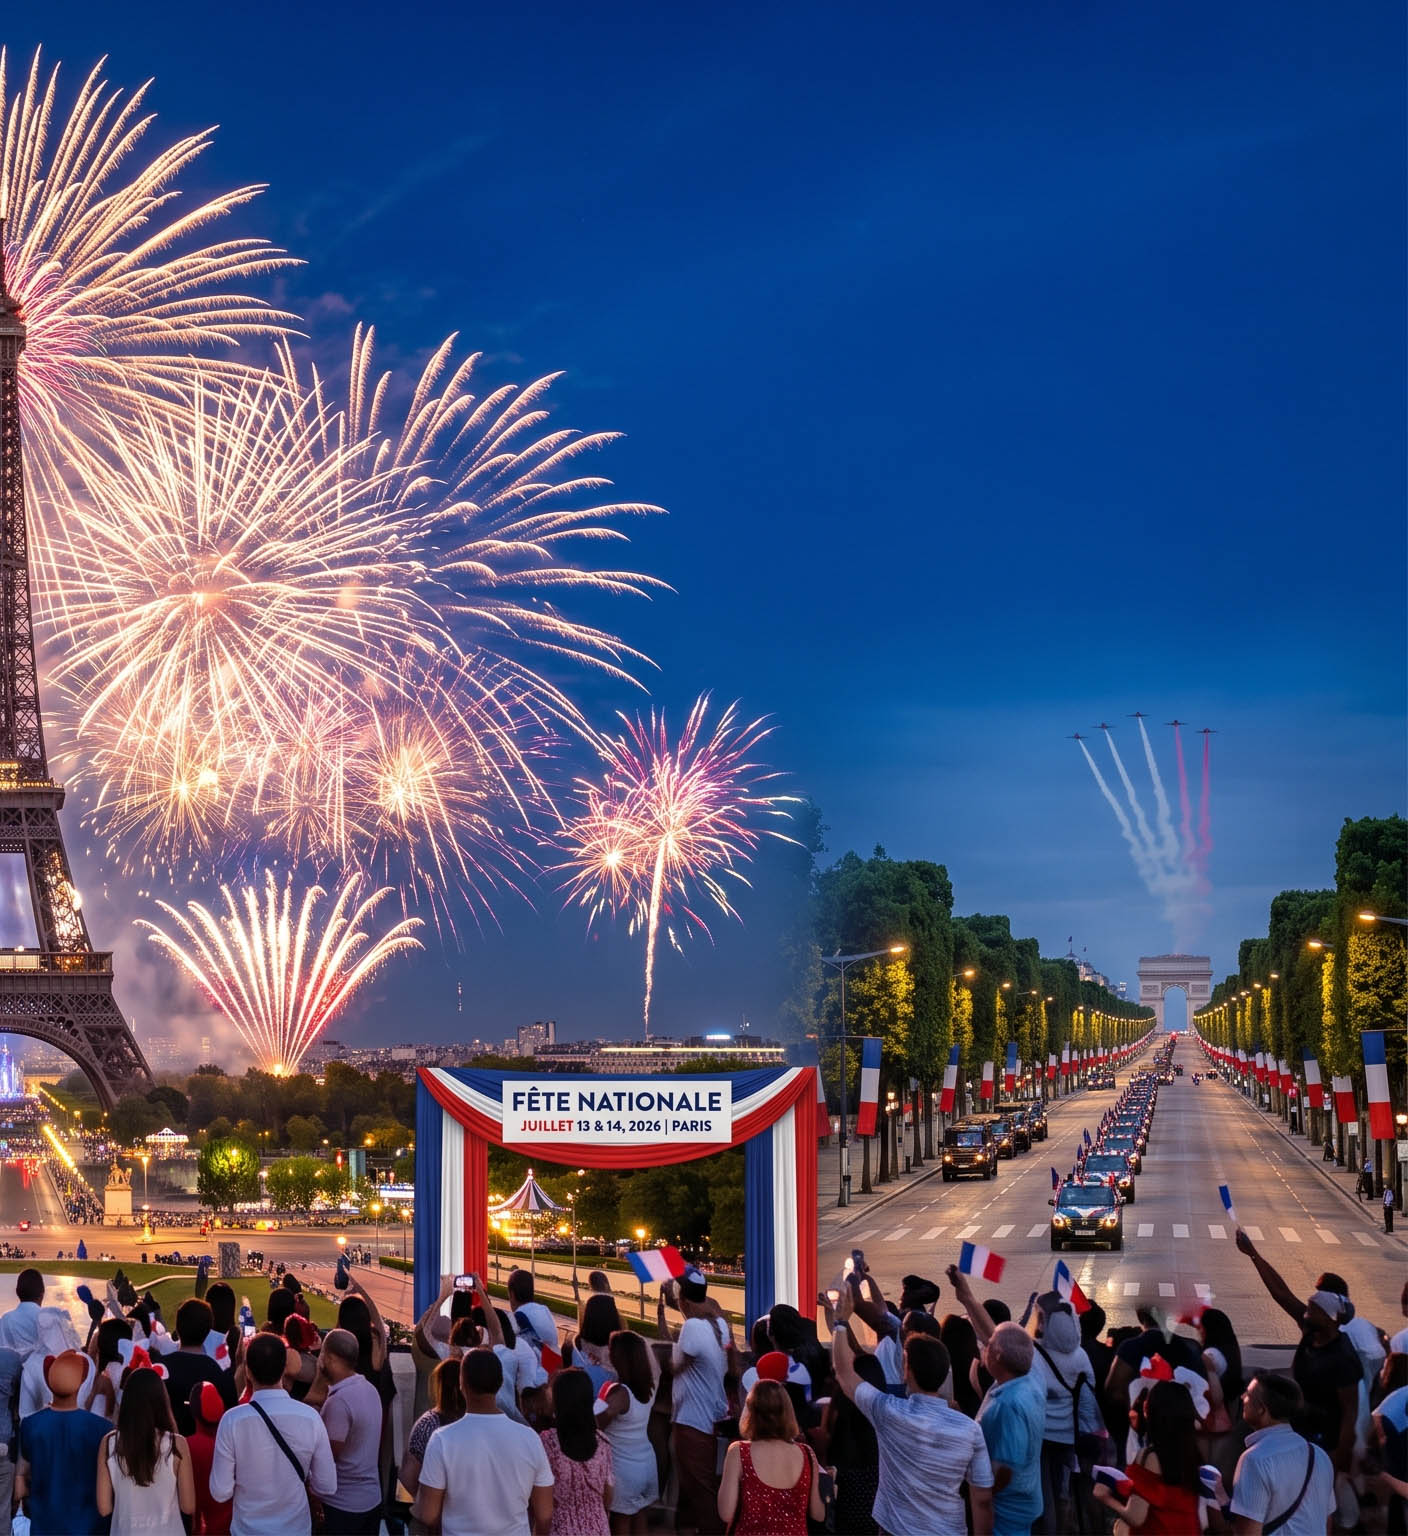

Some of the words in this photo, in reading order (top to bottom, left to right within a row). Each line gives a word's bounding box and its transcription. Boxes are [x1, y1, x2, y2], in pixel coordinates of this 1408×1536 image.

[512, 1085, 571, 1112] FÊTE
[578, 1091, 722, 1112] NATIONALE
[520, 1119, 574, 1132] JUILLET
[576, 1119, 591, 1132] 13
[594, 1119, 604, 1132] &
[606, 1119, 626, 1135] 14,
[628, 1119, 662, 1132] 2026
[672, 1119, 712, 1132] PARIS
